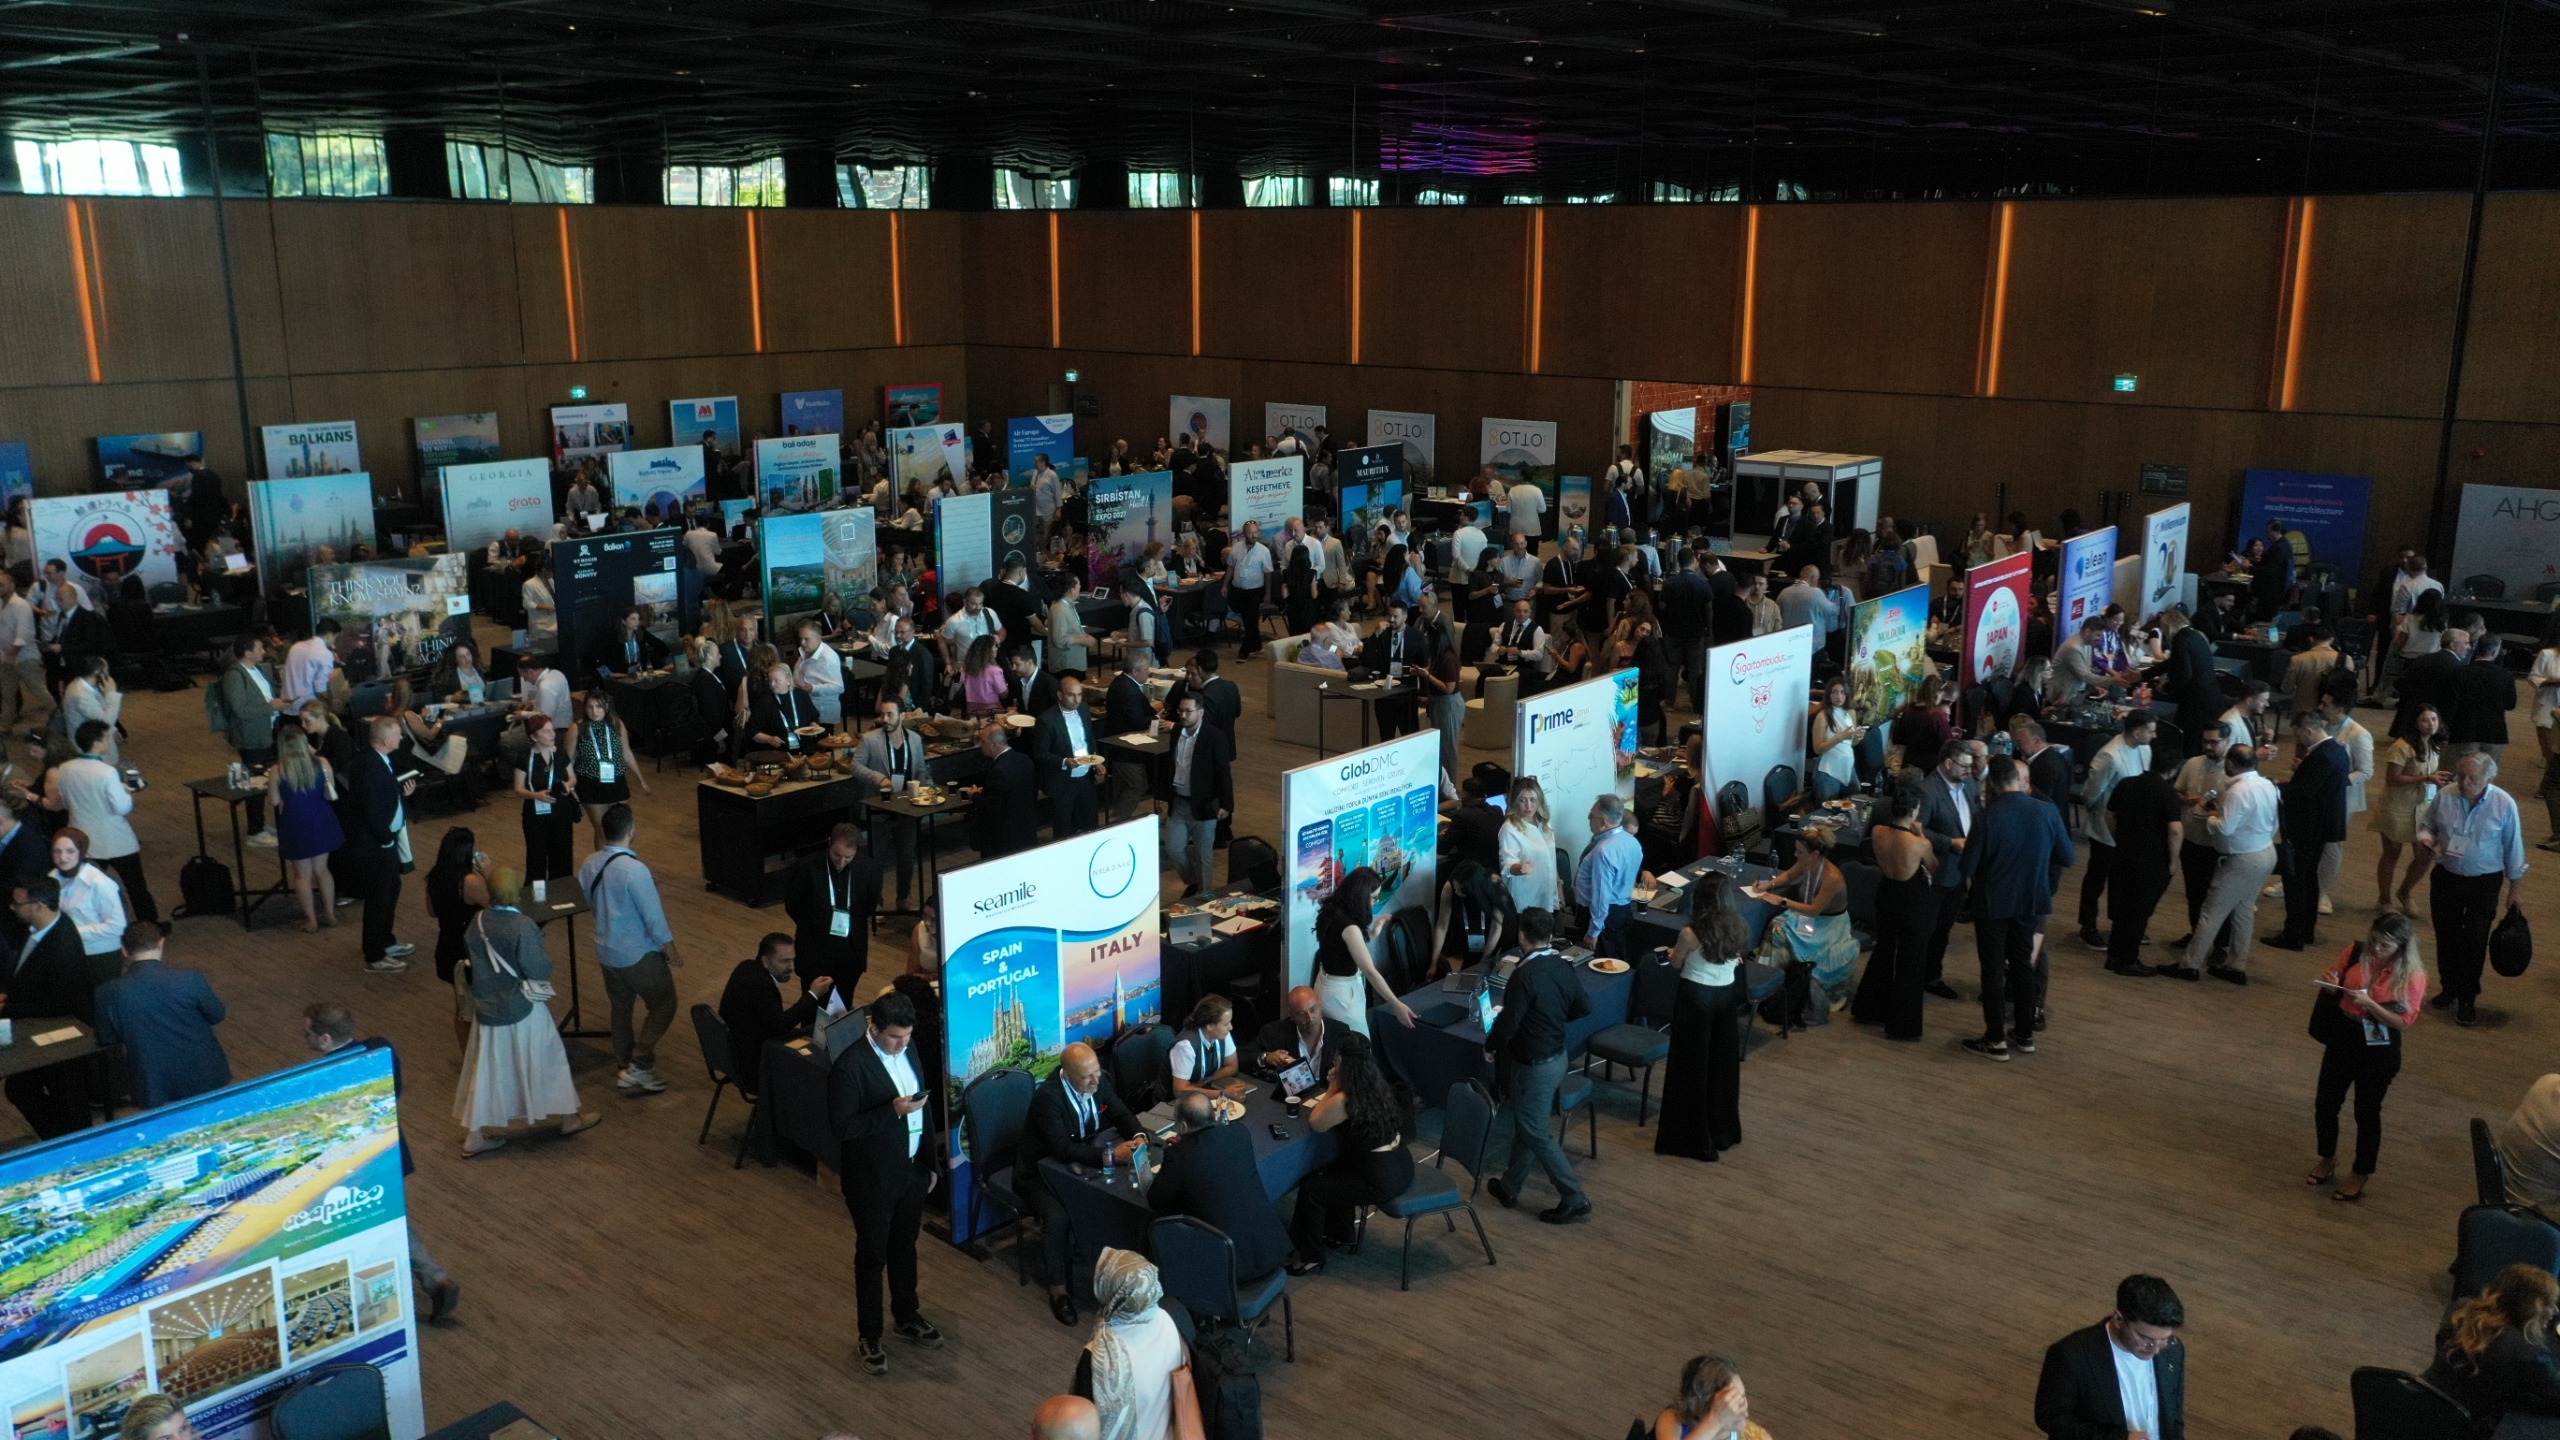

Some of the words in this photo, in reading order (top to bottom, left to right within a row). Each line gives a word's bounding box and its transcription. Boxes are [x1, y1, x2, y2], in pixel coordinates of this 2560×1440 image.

[288, 430, 354, 447] BALKANS
[782, 440, 796, 448] bali
[469, 469, 532, 481] GEORGIA
[1357, 465, 1389, 477] MAURITIUS
[1095, 489, 1141, 504] SIRBİSTAN
[1246, 481, 1291, 495] KEŞFETMEYE
[508, 496, 542, 512] grata
[2263, 504, 2295, 513] modern
[2296, 505, 2345, 516] architecture
[1096, 512, 1112, 521] EXPO
[603, 542, 625, 552] Balkan
[2085, 551, 2107, 570] alean
[329, 578, 374, 594] THINK
[375, 574, 406, 588] YOU
[329, 590, 374, 606] KNOW
[376, 583, 420, 601] SPAIN?
[1987, 626, 2009, 646] JAPAN
[418, 650, 445, 665] AGA
[1340, 750, 1399, 781] GlobDMC
[974, 881, 1037, 915] seamile
[982, 941, 1023, 966] SPAIN
[1090, 931, 1144, 964] ITALY
[998, 961, 1009, 974] &
[967, 964, 1040, 999] PORTUGAL
[283, 1184, 385, 1232] acapulco
[223, 1378, 286, 1411] CONVENTION
